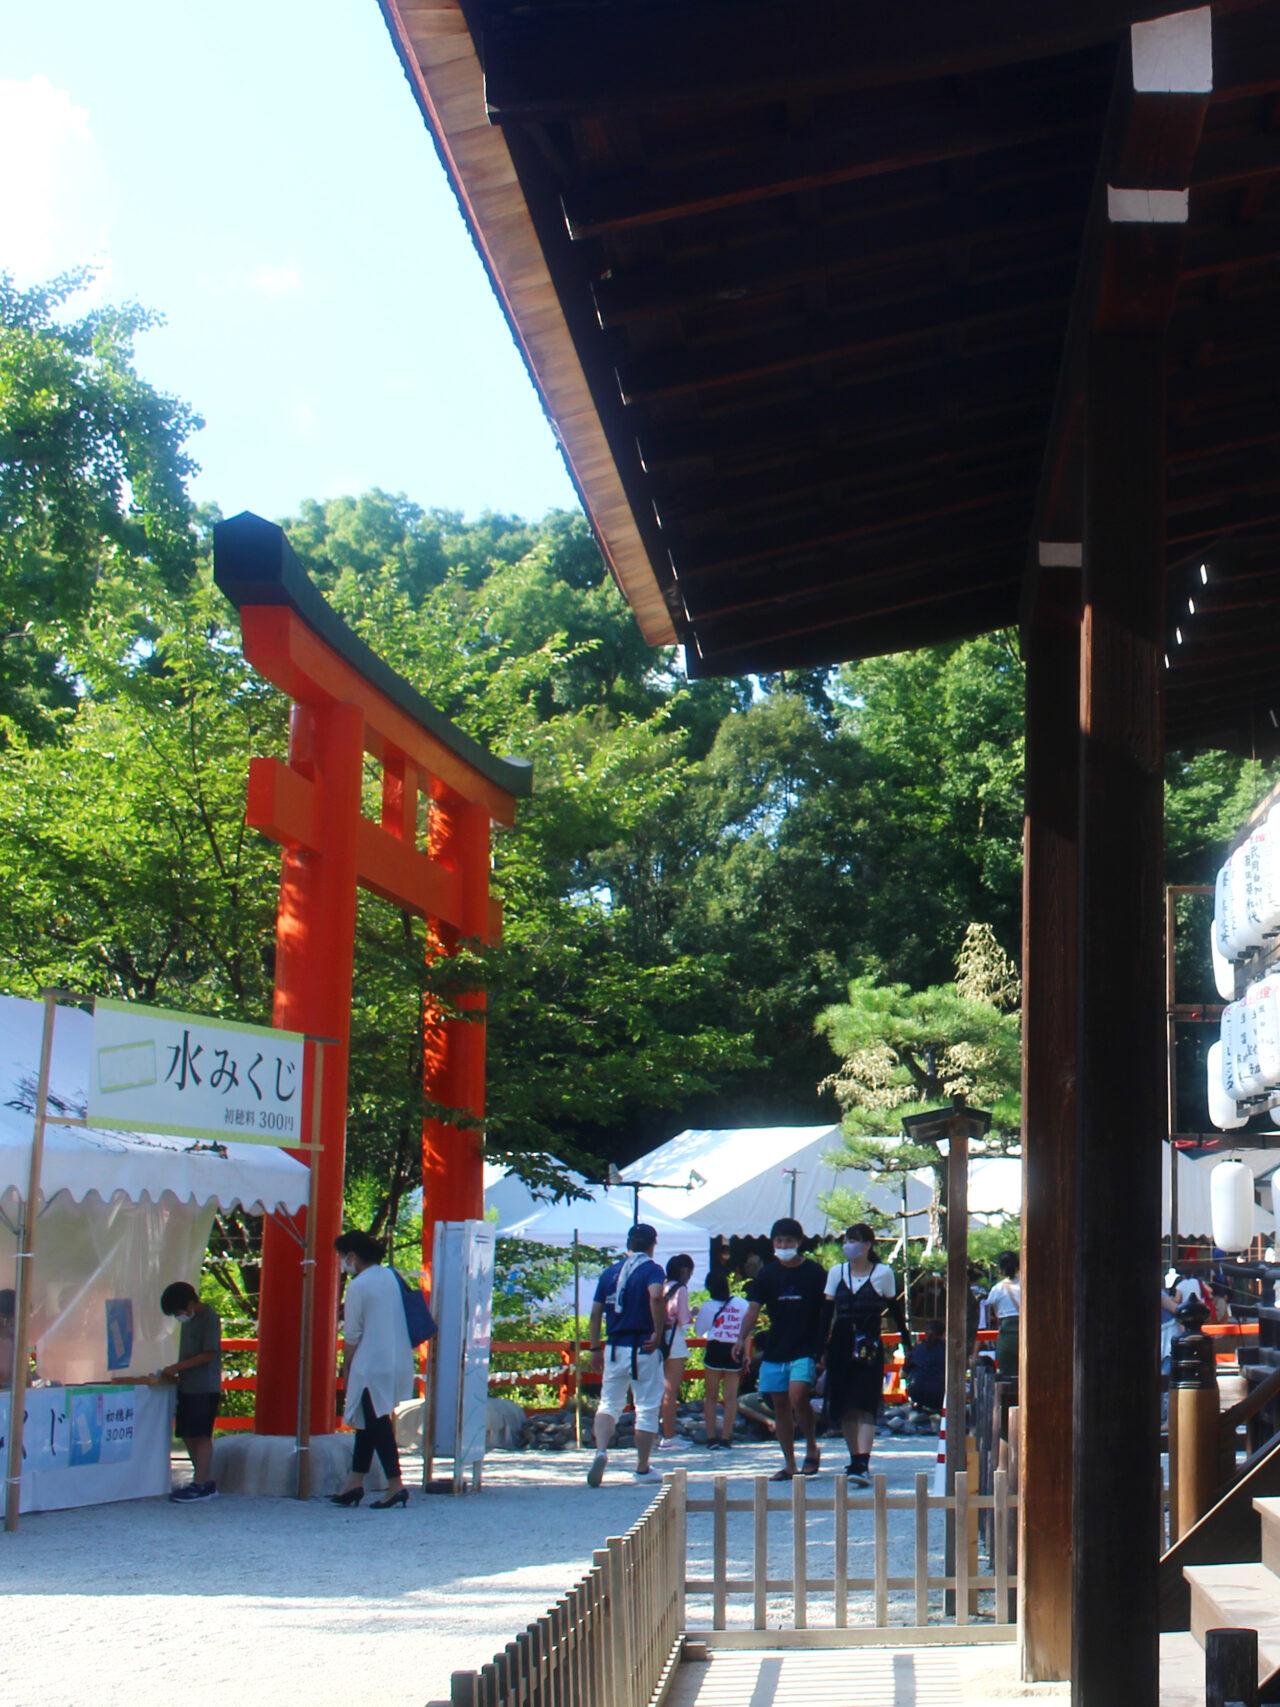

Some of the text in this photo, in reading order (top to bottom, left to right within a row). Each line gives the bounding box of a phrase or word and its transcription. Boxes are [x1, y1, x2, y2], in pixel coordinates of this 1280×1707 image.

[164, 1030, 296, 1102] 水みくじ
[224, 1107, 294, 1132] 初穂料 300円
[105, 1426, 134, 1442] 300円
